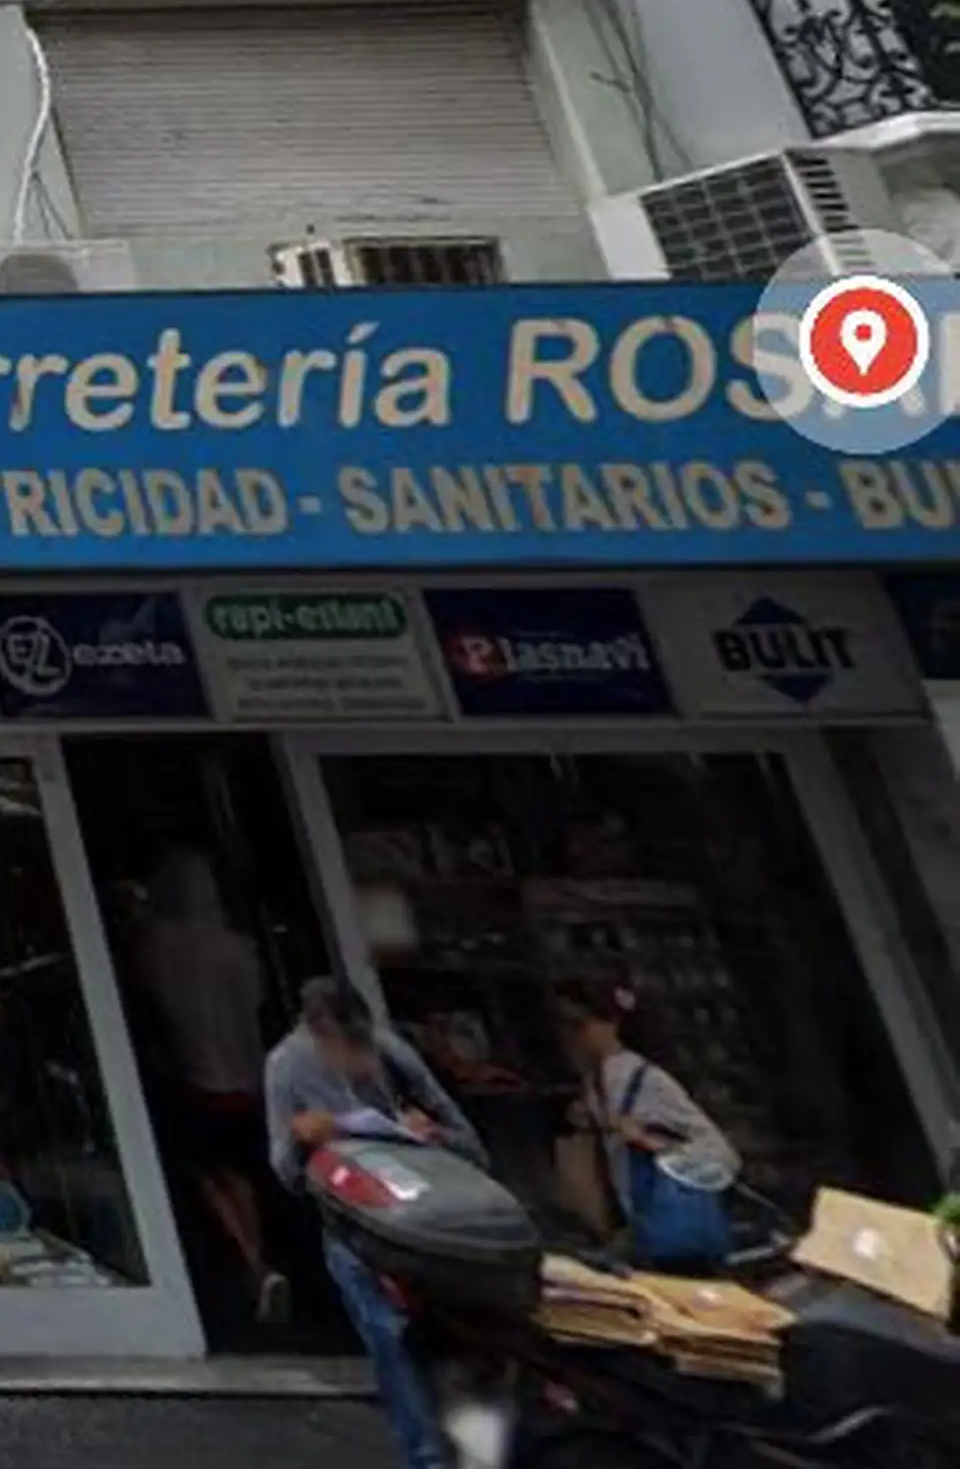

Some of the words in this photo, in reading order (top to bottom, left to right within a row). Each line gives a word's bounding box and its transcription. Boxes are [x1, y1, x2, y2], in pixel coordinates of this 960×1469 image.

[505, 315, 960, 423] ROS
[338, 460, 792, 533] SANITARIOS
[838, 458, 960, 529] BU
[712, 626, 858, 671] BULIT
